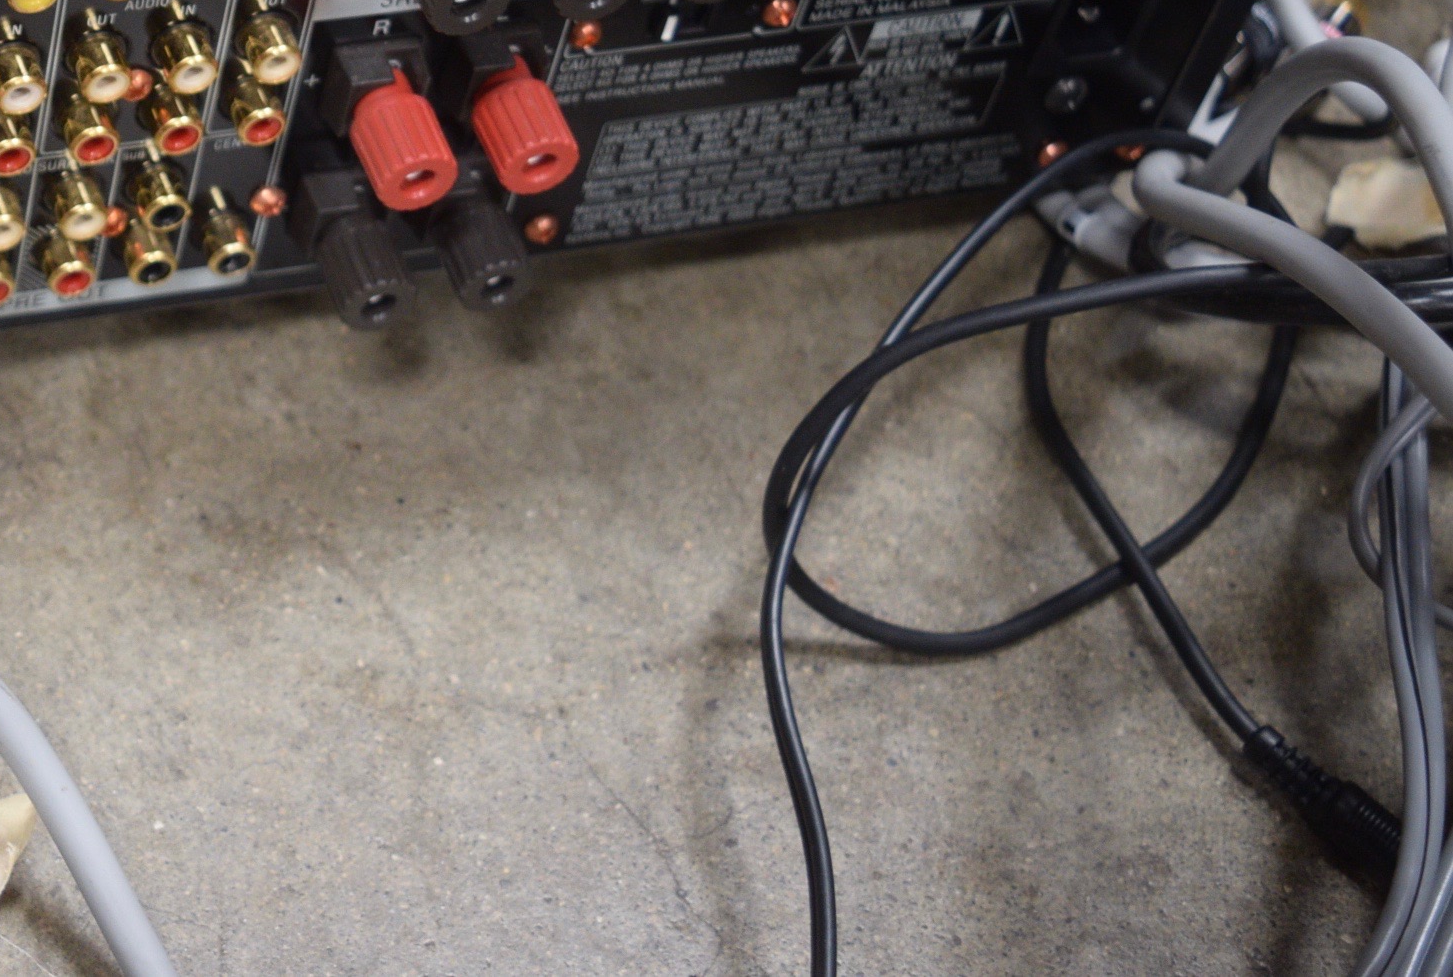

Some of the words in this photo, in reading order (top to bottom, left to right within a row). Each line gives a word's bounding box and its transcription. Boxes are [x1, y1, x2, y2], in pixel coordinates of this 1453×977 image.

[179, 3, 197, 16] IN
[87, 11, 118, 26] OUT
[373, 18, 393, 36] R
